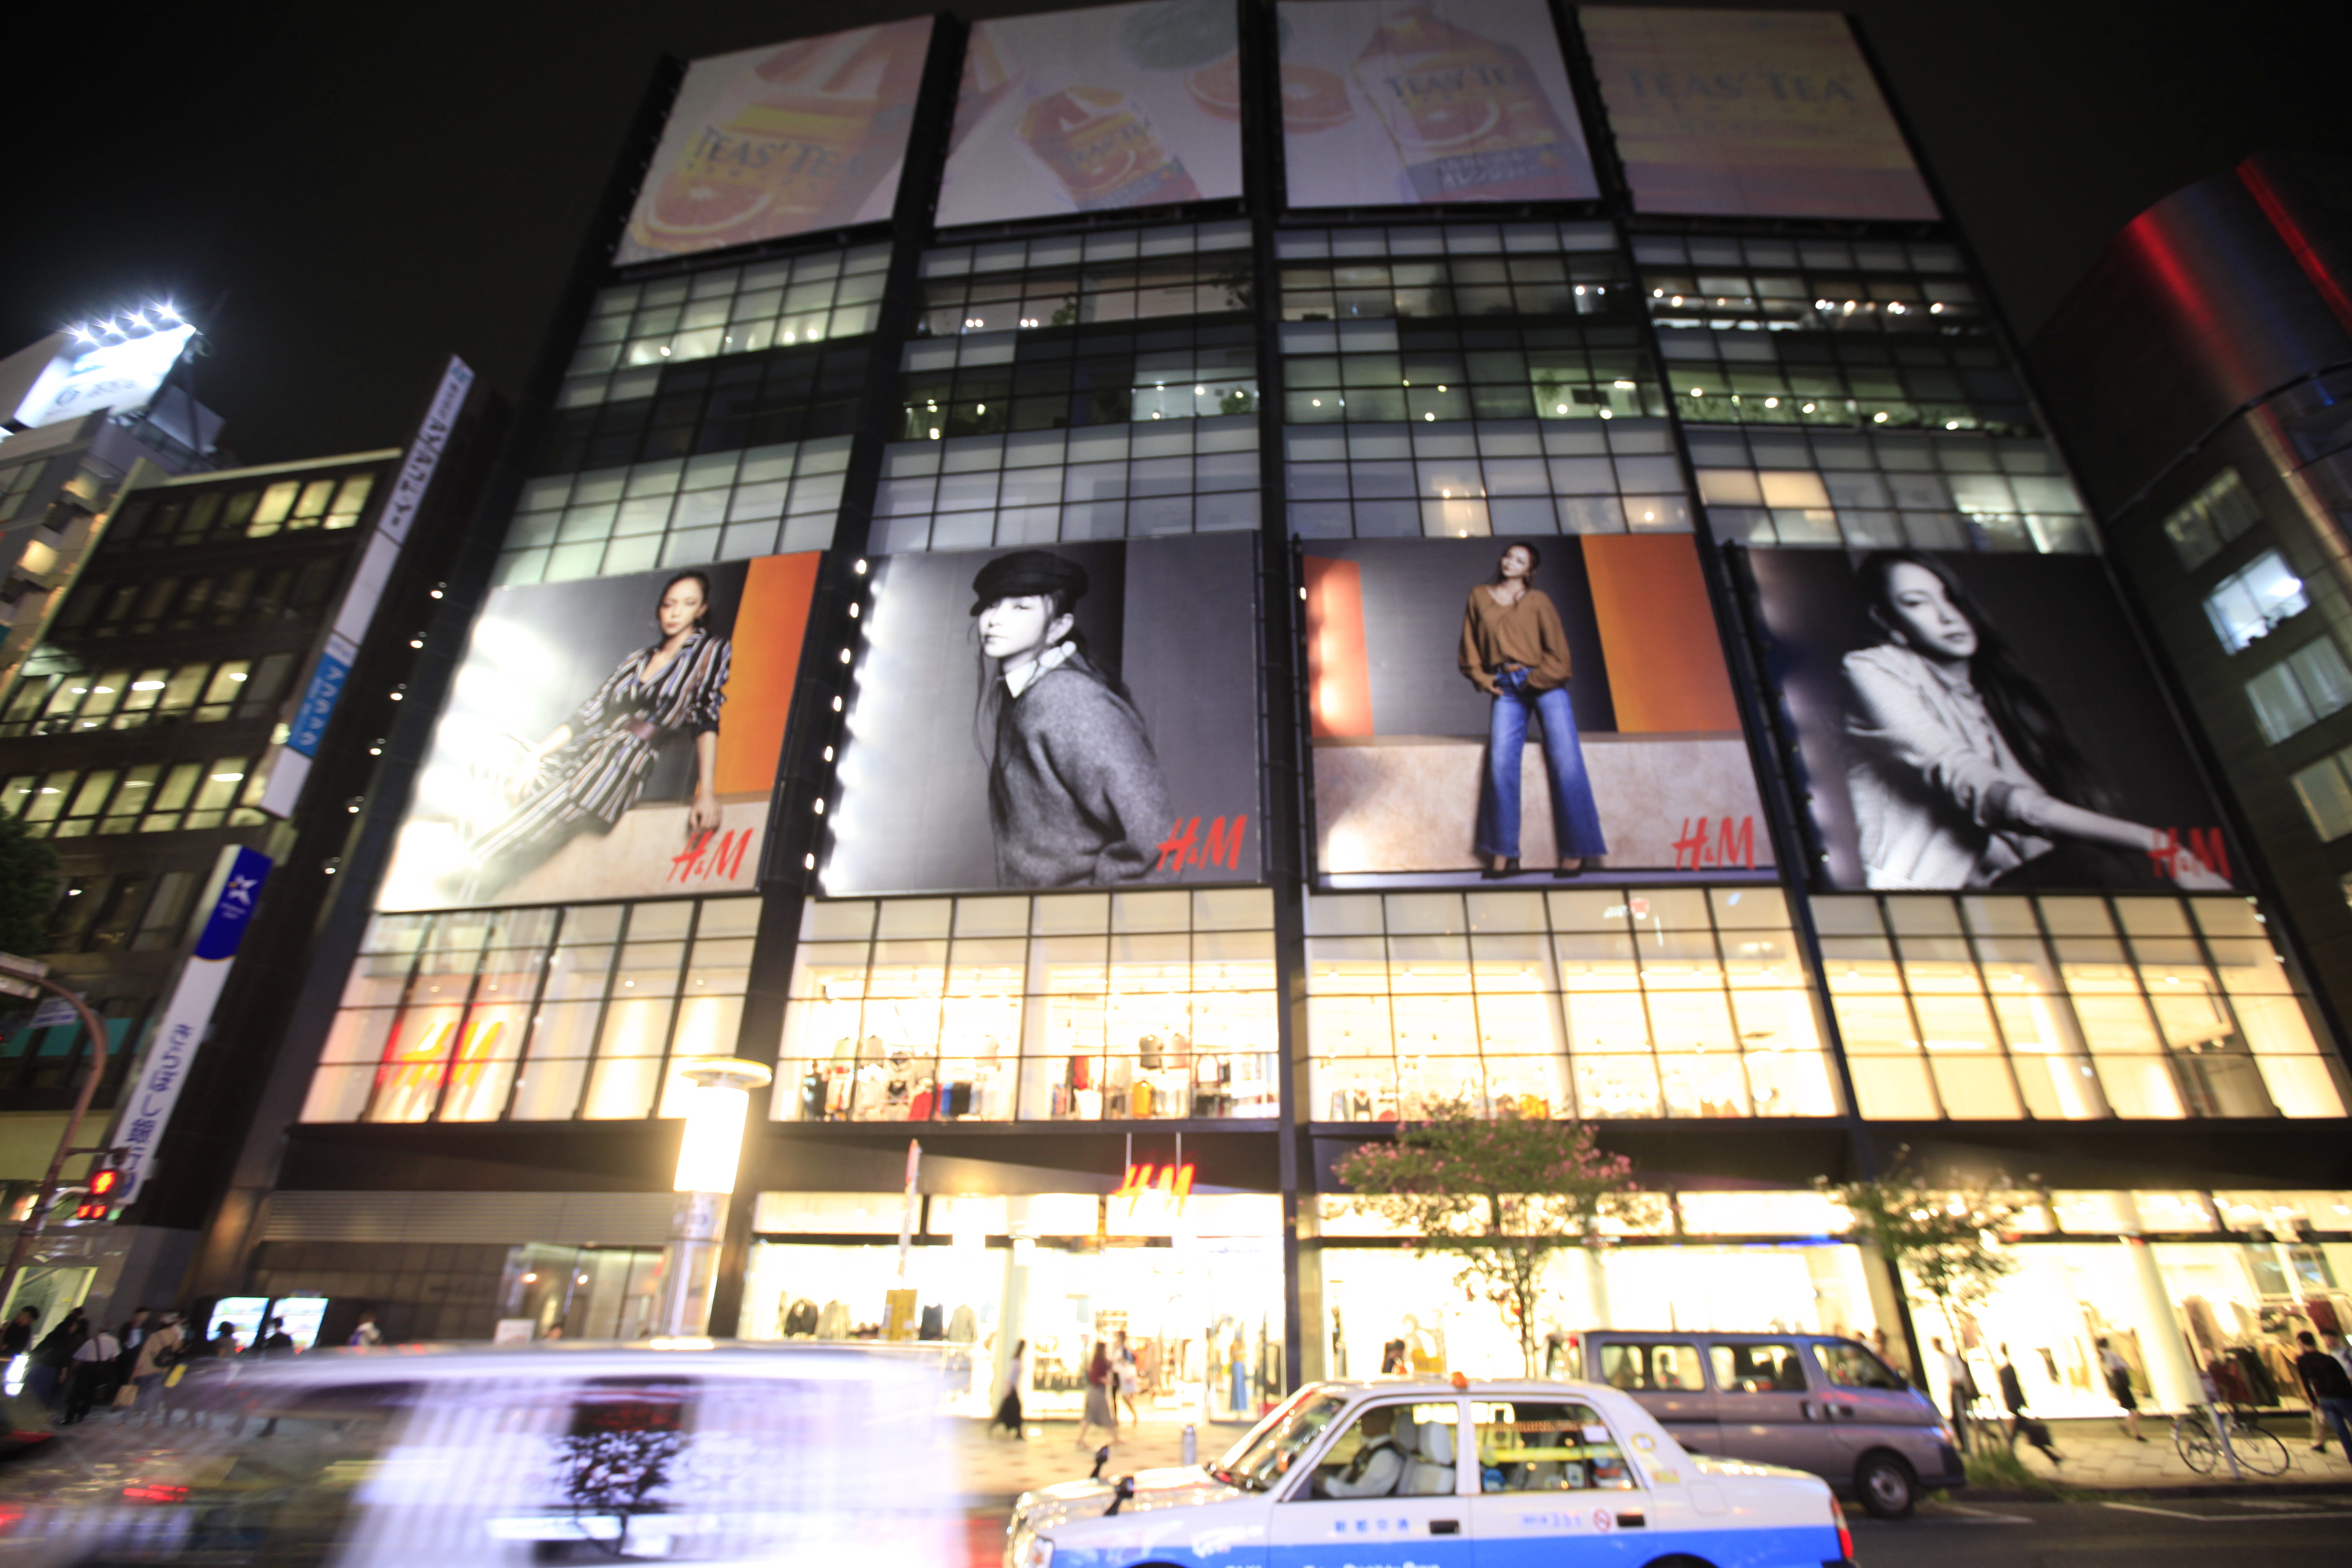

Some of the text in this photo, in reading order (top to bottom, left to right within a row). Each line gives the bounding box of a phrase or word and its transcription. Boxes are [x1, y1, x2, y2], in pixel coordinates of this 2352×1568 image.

[1754, 72, 1856, 102] TEA
[694, 125, 789, 168] TEAS'
[666, 827, 753, 884] H&M
[1156, 814, 1247, 872] H&M
[1671, 815, 1756, 871] H&M
[2146, 827, 2233, 879] H&M
[1110, 1162, 1196, 1218] HM
